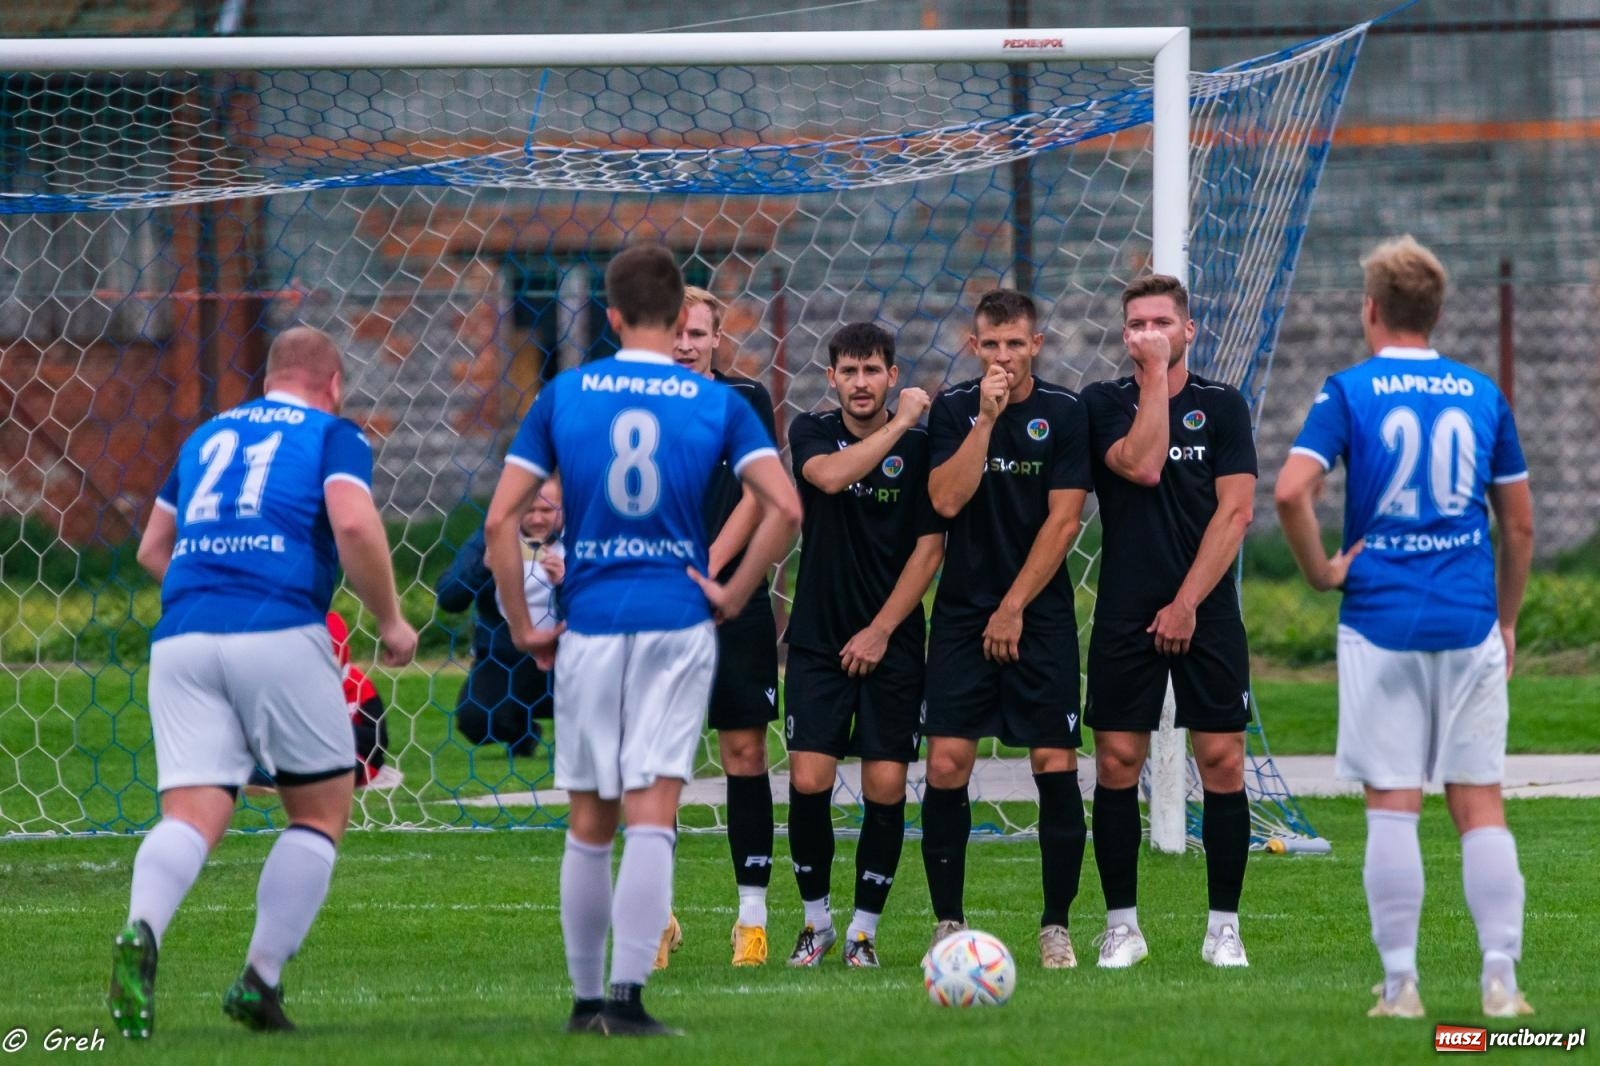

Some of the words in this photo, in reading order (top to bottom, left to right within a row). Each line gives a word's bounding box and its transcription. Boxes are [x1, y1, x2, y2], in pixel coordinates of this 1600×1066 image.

[581, 373, 699, 399] NAPRZÓD
[1371, 372, 1475, 396] NAPRZÓD
[184, 428, 283, 526] 21
[605, 407, 661, 519] 8
[1375, 405, 1477, 520] 20
